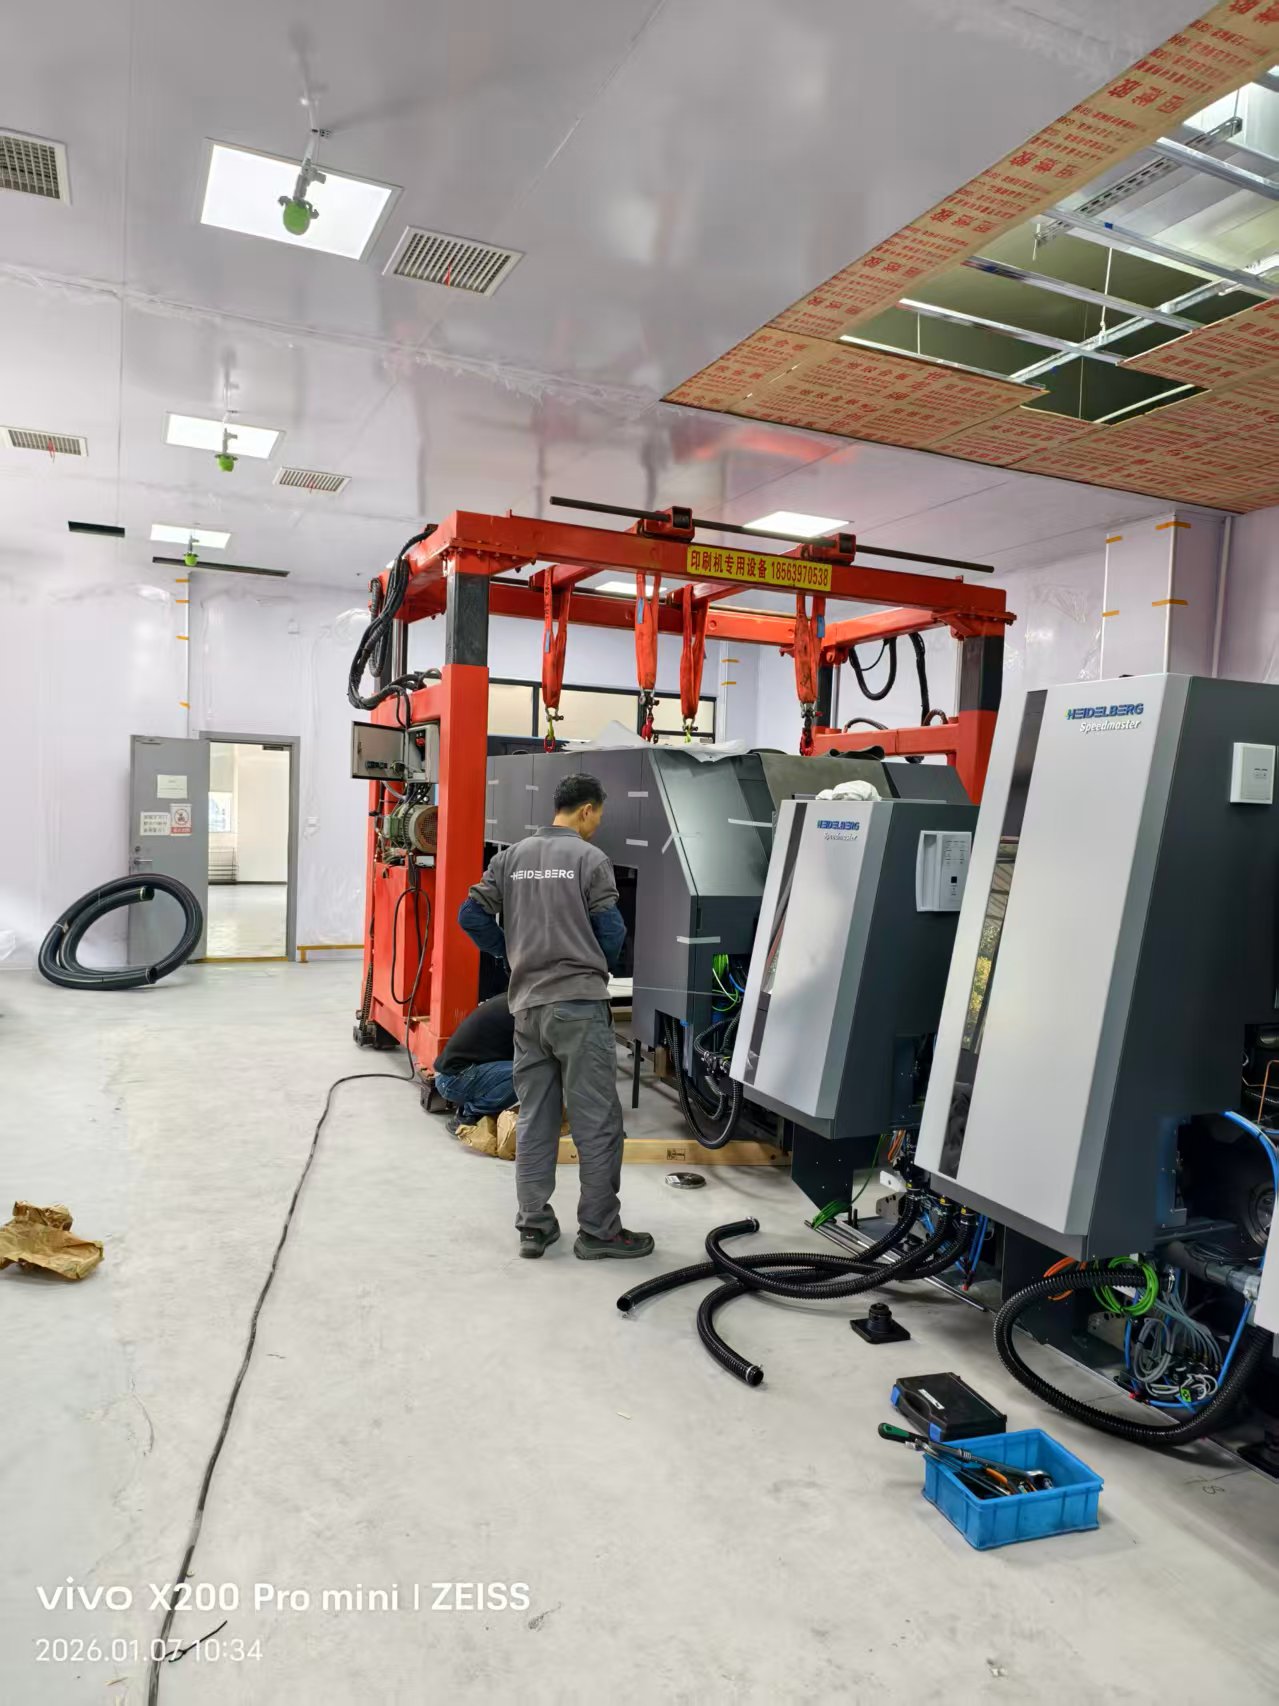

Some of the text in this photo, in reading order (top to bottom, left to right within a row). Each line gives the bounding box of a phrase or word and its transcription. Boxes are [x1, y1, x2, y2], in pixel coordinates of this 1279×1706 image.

[690, 549, 829, 587] 印刷机专用设备 18563970538
[1065, 703, 1144, 720] HEIDELBERG
[1079, 719, 1142, 734] Speedmaster
[510, 869, 575, 881] HEIDELBERG
